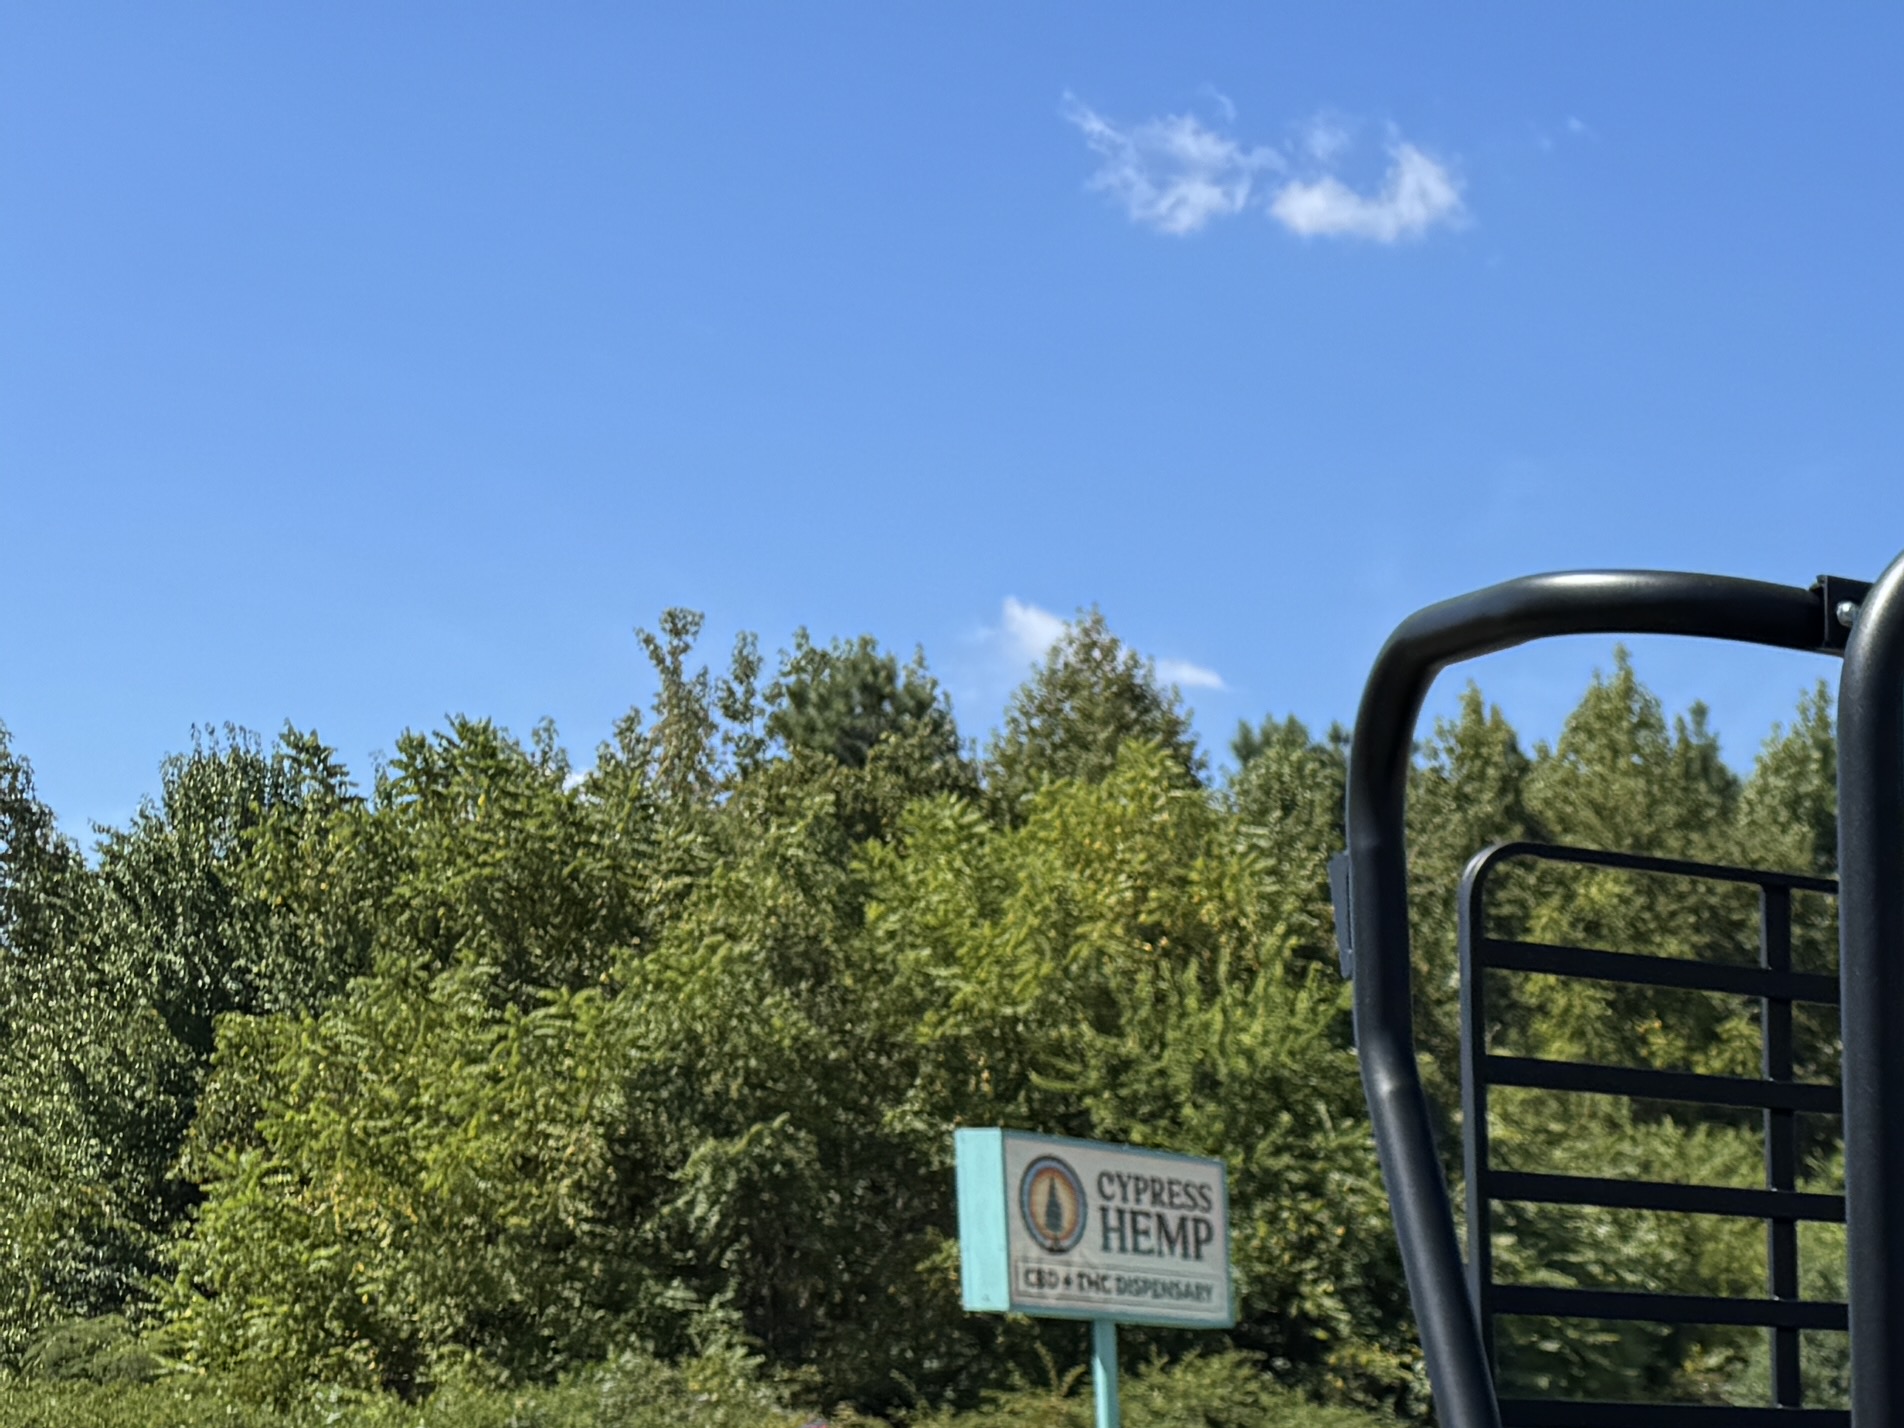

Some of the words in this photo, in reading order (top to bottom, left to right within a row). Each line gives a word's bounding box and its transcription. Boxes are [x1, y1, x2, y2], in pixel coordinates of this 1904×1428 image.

[1097, 1171, 1213, 1214] CYPRESS
[1098, 1206, 1214, 1262] HEMP
[1024, 1267, 1060, 1290] CBD
[1076, 1271, 1113, 1294] THC
